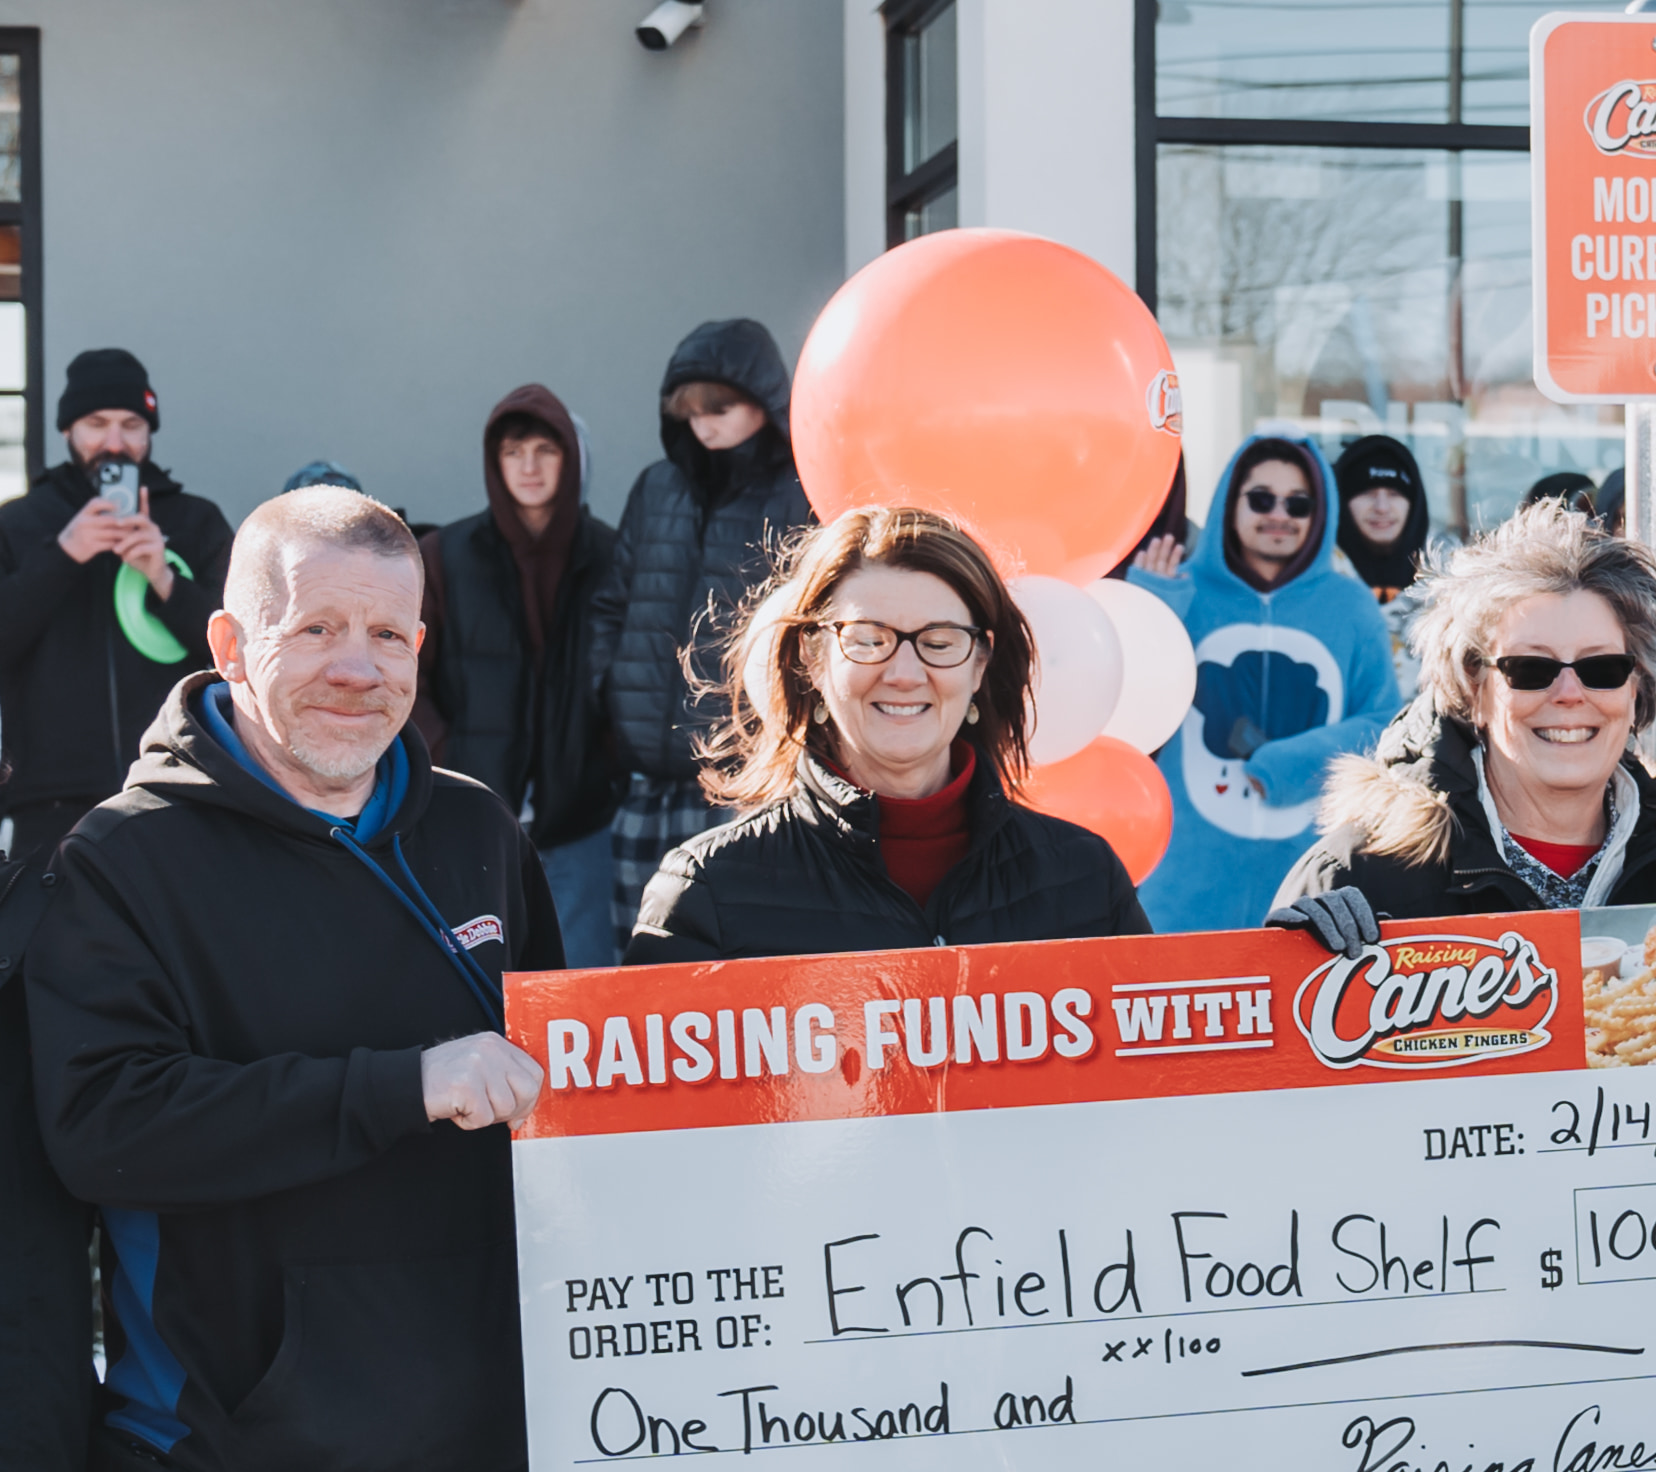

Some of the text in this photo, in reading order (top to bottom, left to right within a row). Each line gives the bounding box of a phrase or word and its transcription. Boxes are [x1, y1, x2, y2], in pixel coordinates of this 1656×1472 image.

[1395, 944, 1478, 969] Raising
[1309, 932, 1557, 1067] Cane's
[545, 986, 1274, 1091] RAISING FUNDS WITH
[1392, 1029, 1529, 1055] CHICKEN FINGERS
[1423, 1124, 1525, 1161] DATE:
[564, 1265, 786, 1313] PAY TO THE
[824, 1209, 1501, 1338] Enfield Food Shelf
[568, 1314, 774, 1360] ORDER OF:
[590, 1386, 720, 1457] One
[716, 1381, 951, 1456] Thousand
[993, 1375, 1077, 1430] and
